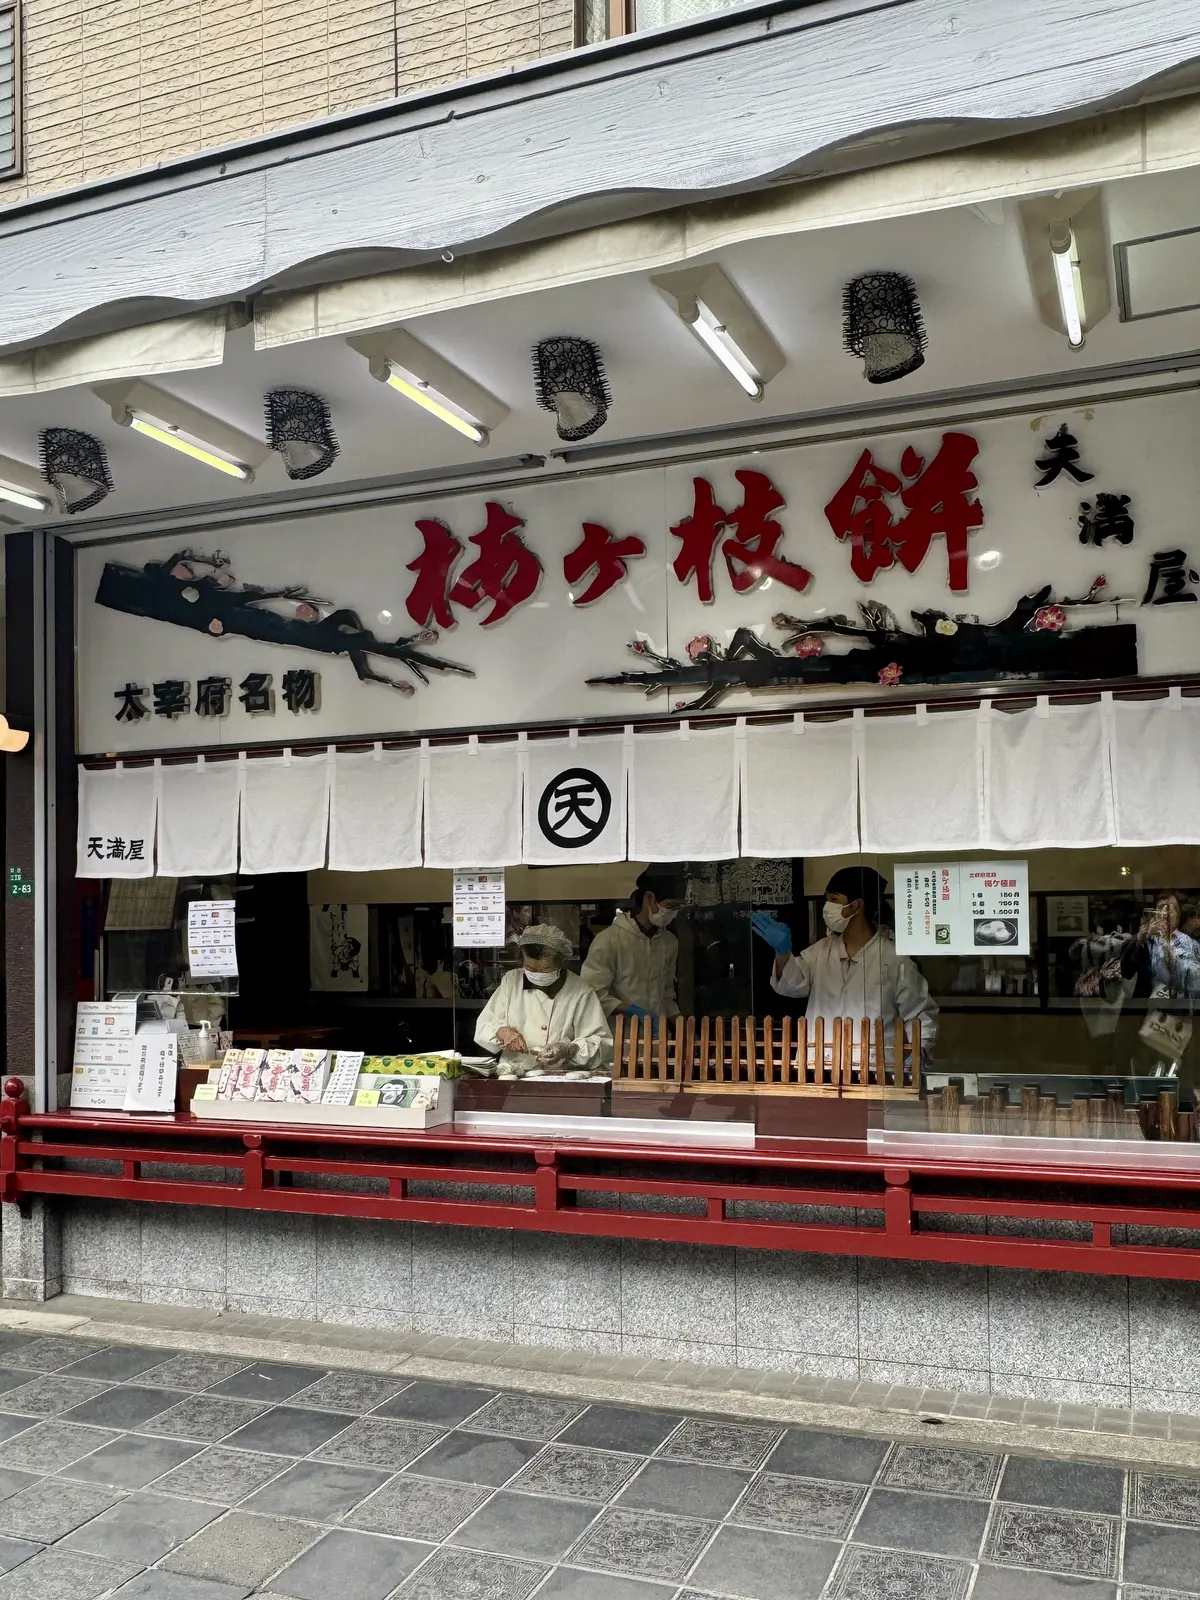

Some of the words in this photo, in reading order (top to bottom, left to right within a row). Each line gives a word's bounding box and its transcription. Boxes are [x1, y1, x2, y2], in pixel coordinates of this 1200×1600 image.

[1034, 422, 1200, 607] 天満屋
[113, 668, 321, 722] 太宰府名物
[87, 837, 145, 861] 天満屋
